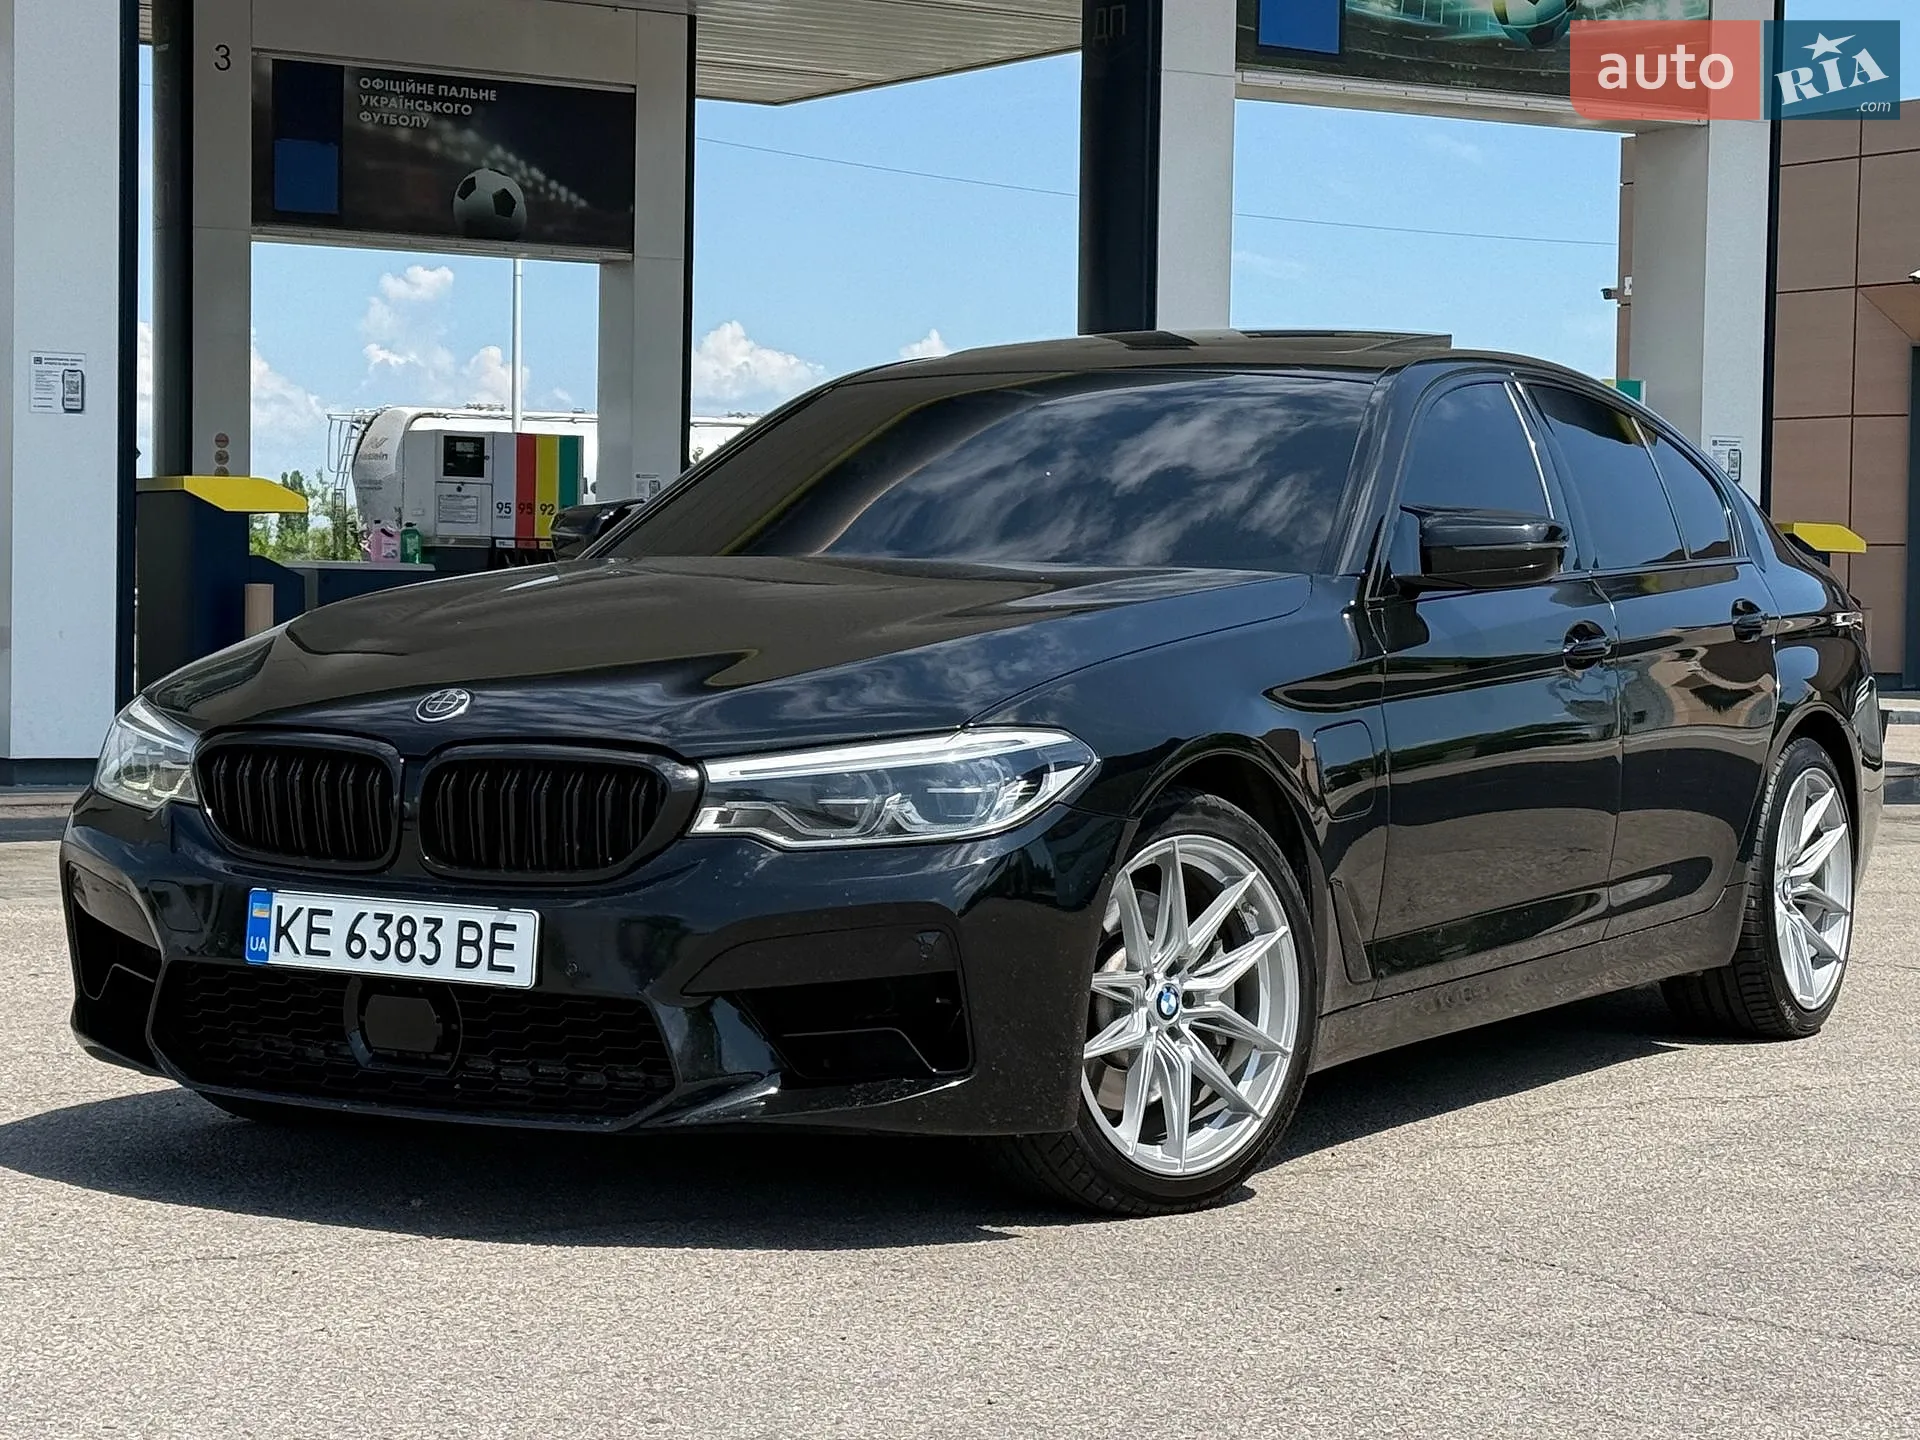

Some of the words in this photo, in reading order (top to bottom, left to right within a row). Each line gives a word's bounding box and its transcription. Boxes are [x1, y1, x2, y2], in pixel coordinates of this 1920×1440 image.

[214, 44, 231, 71] 3
[359, 76, 435, 96] ОФІЦІЙНЕ
[438, 84, 497, 102] ПАЛЬНЕ
[359, 94, 473, 116] УКРАЇНСЬКОГО
[359, 110, 431, 128] ФУТБОЛУ
[496, 502, 512, 515] 95
[518, 502, 534, 515] 95
[540, 503, 556, 516] 92
[250, 935, 268, 953] UA
[274, 905, 333, 958] KE
[345, 911, 444, 967] 6383
[455, 919, 518, 973] BE
